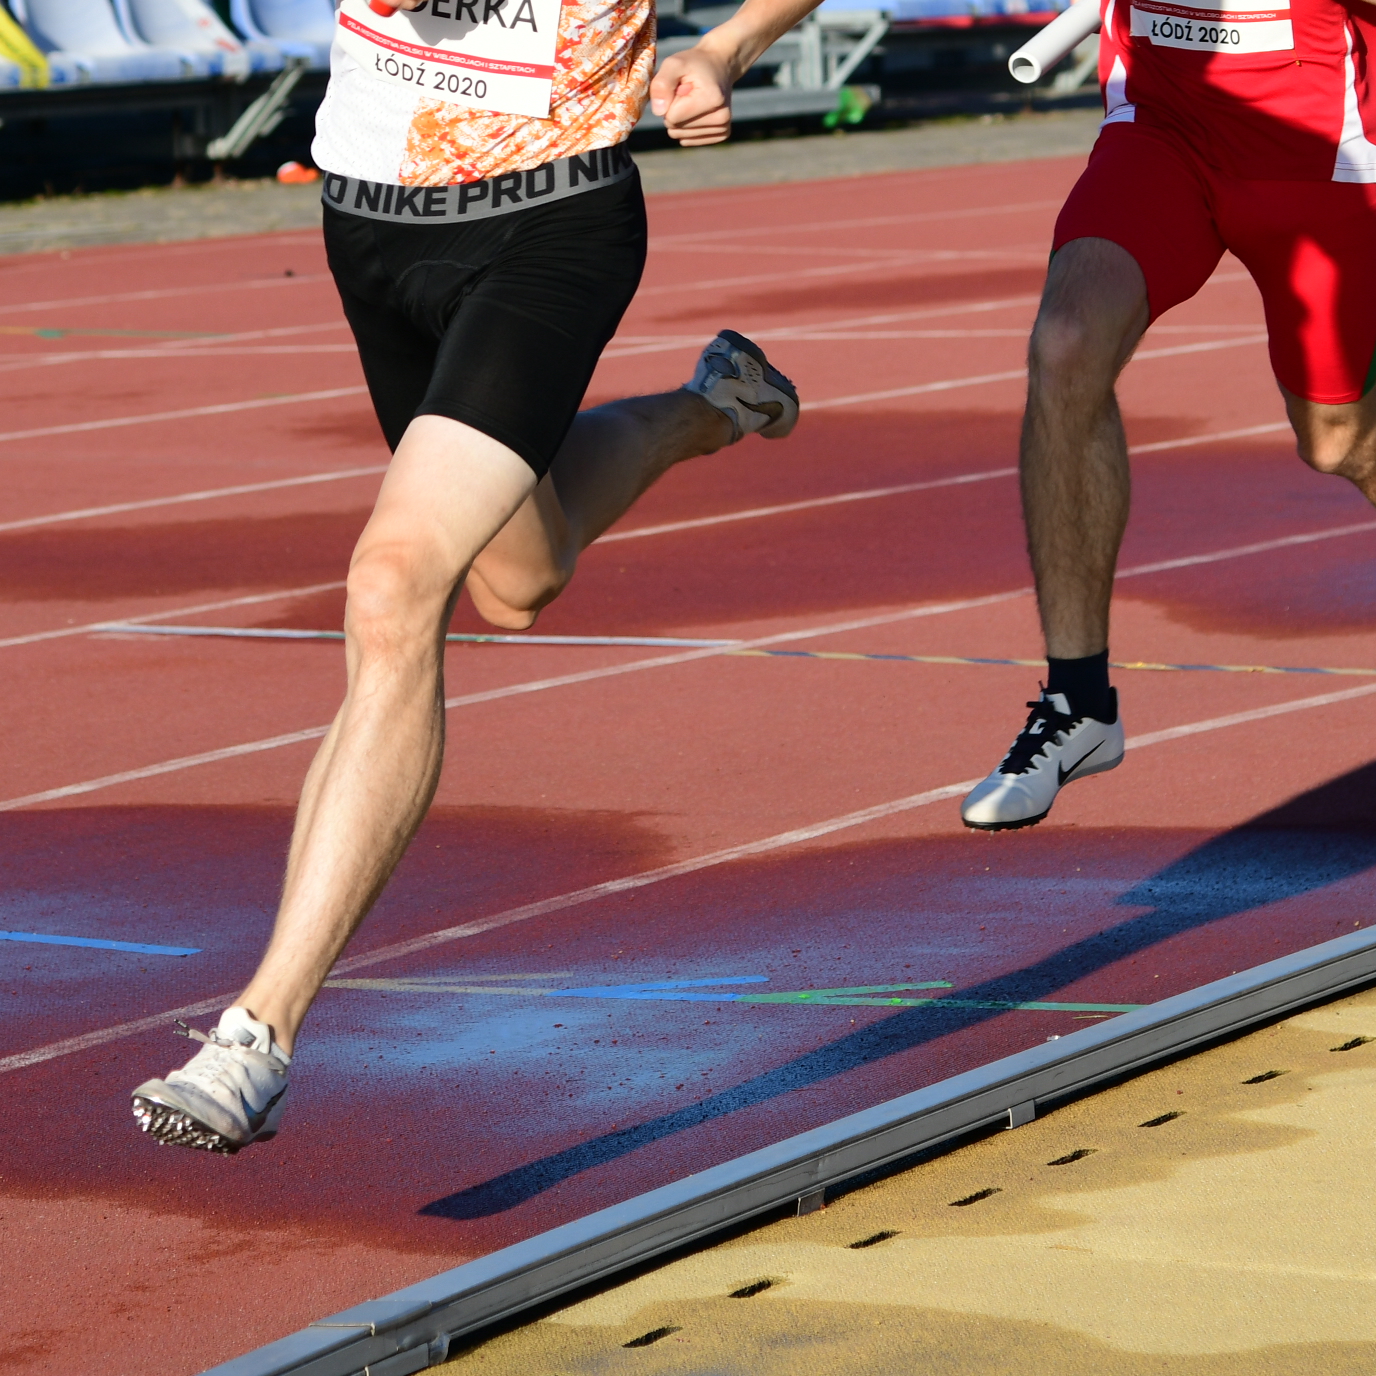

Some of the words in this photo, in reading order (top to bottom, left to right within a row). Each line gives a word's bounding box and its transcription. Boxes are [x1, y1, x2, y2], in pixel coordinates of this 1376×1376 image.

[1152, 17, 1194, 42] ŁÓDŹ
[1198, 26, 1241, 45] 2020
[375, 53, 425, 86] ŁÓDŹ
[433, 71, 487, 99] 2020
[326, 173, 348, 204] O
[354, 175, 449, 217] NIKE
[457, 163, 555, 215] PRO
[569, 146, 633, 187] NIK
